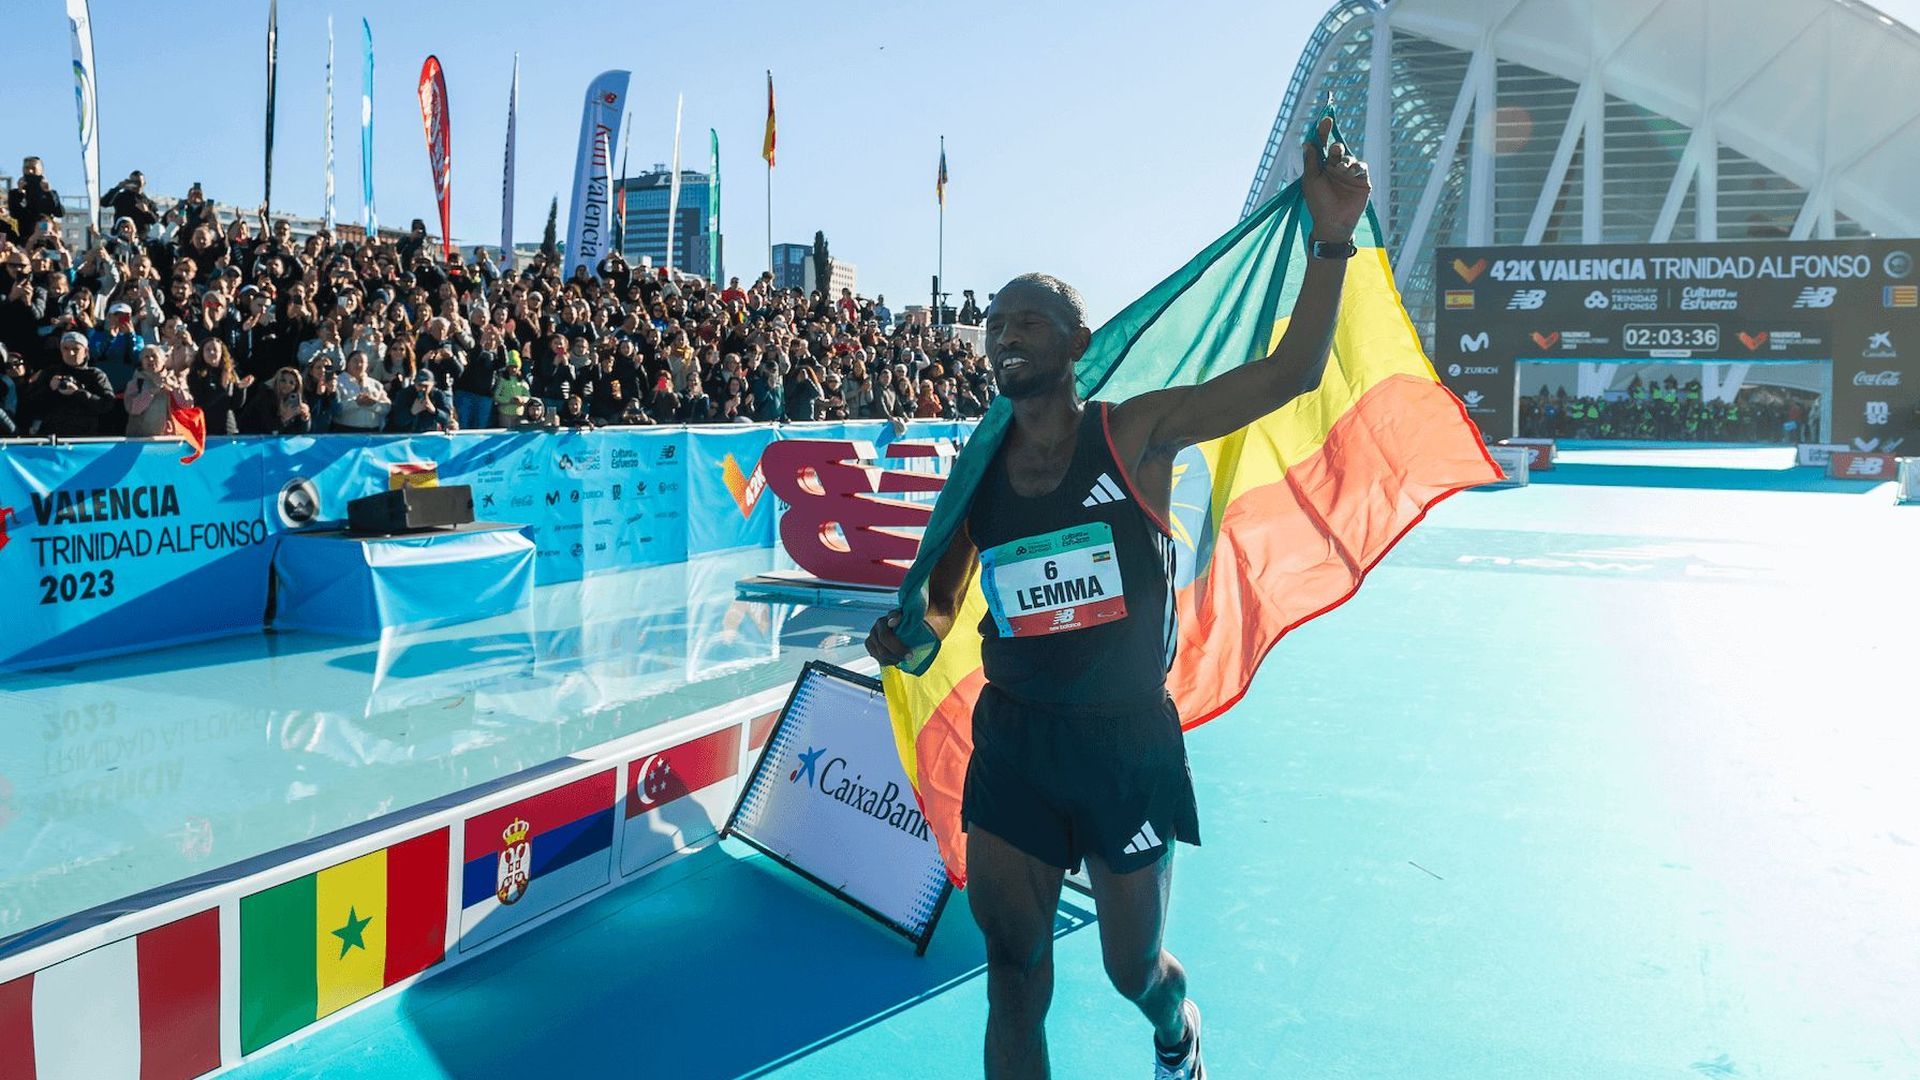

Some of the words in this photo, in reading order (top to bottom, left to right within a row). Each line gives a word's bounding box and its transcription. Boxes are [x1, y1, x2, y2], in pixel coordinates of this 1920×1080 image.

[580, 175, 608, 258] Valencia
[1490, 259, 1536, 282] 42K
[1538, 258, 1646, 281] VALENCIA
[1650, 256, 1755, 280] TRINIDAD
[1757, 255, 1871, 278] ALFONSO
[1611, 294, 1658, 302] TRINIDAD
[1682, 286, 1727, 299] Cultura
[1611, 302, 1658, 311] ALFONSO
[1680, 298, 1738, 310] Esfuerzo
[1626, 329, 1717, 345] 02:03:36
[1464, 366, 1499, 375] ZURICH
[31, 485, 180, 526] VALENCIA
[31, 528, 153, 567] TRINIDAD
[156, 518, 266, 555] ALFONSO
[1044, 561, 1058, 580] 6
[39, 569, 115, 605] 2023
[1016, 575, 1104, 611] LEMMA
[1060, 621, 1082, 631] balance
[820, 757, 930, 842] CaixaBank
